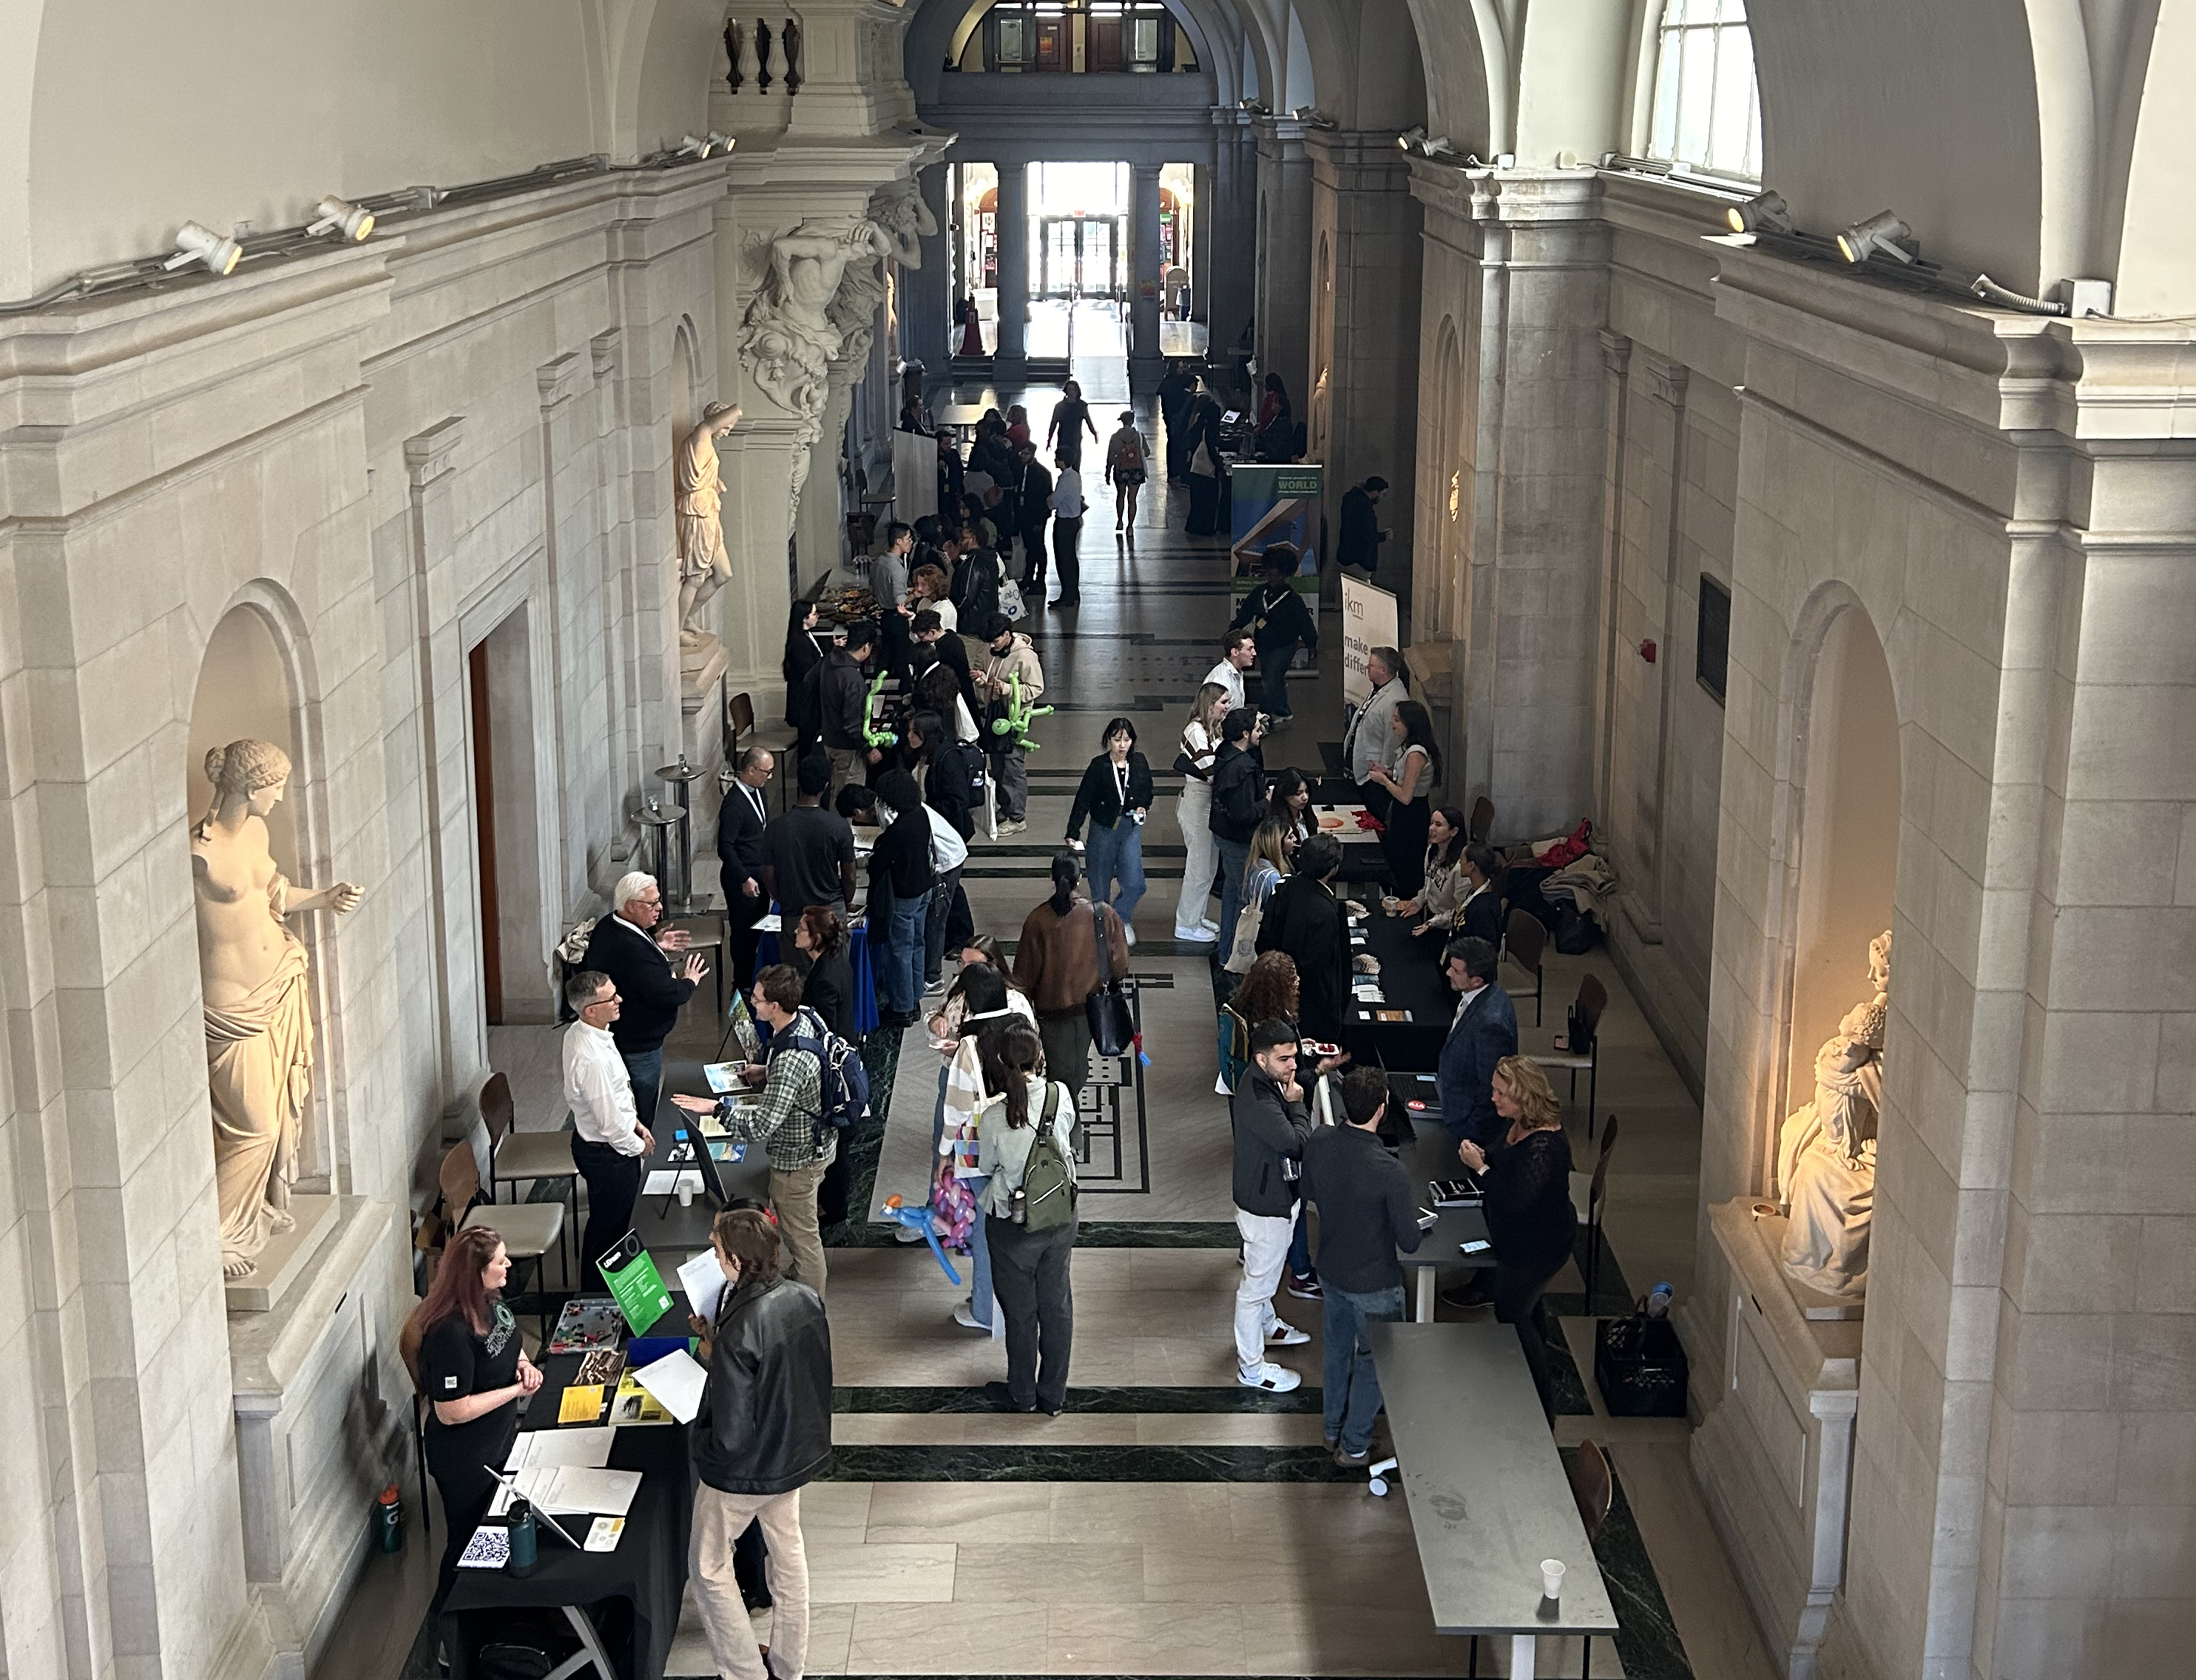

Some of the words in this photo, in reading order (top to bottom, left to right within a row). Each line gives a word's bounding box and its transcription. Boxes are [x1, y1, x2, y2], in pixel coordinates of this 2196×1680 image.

[1278, 481, 1317, 490] WORLD
[1345, 588, 1363, 616] ikm
[1345, 635, 1368, 655] make
